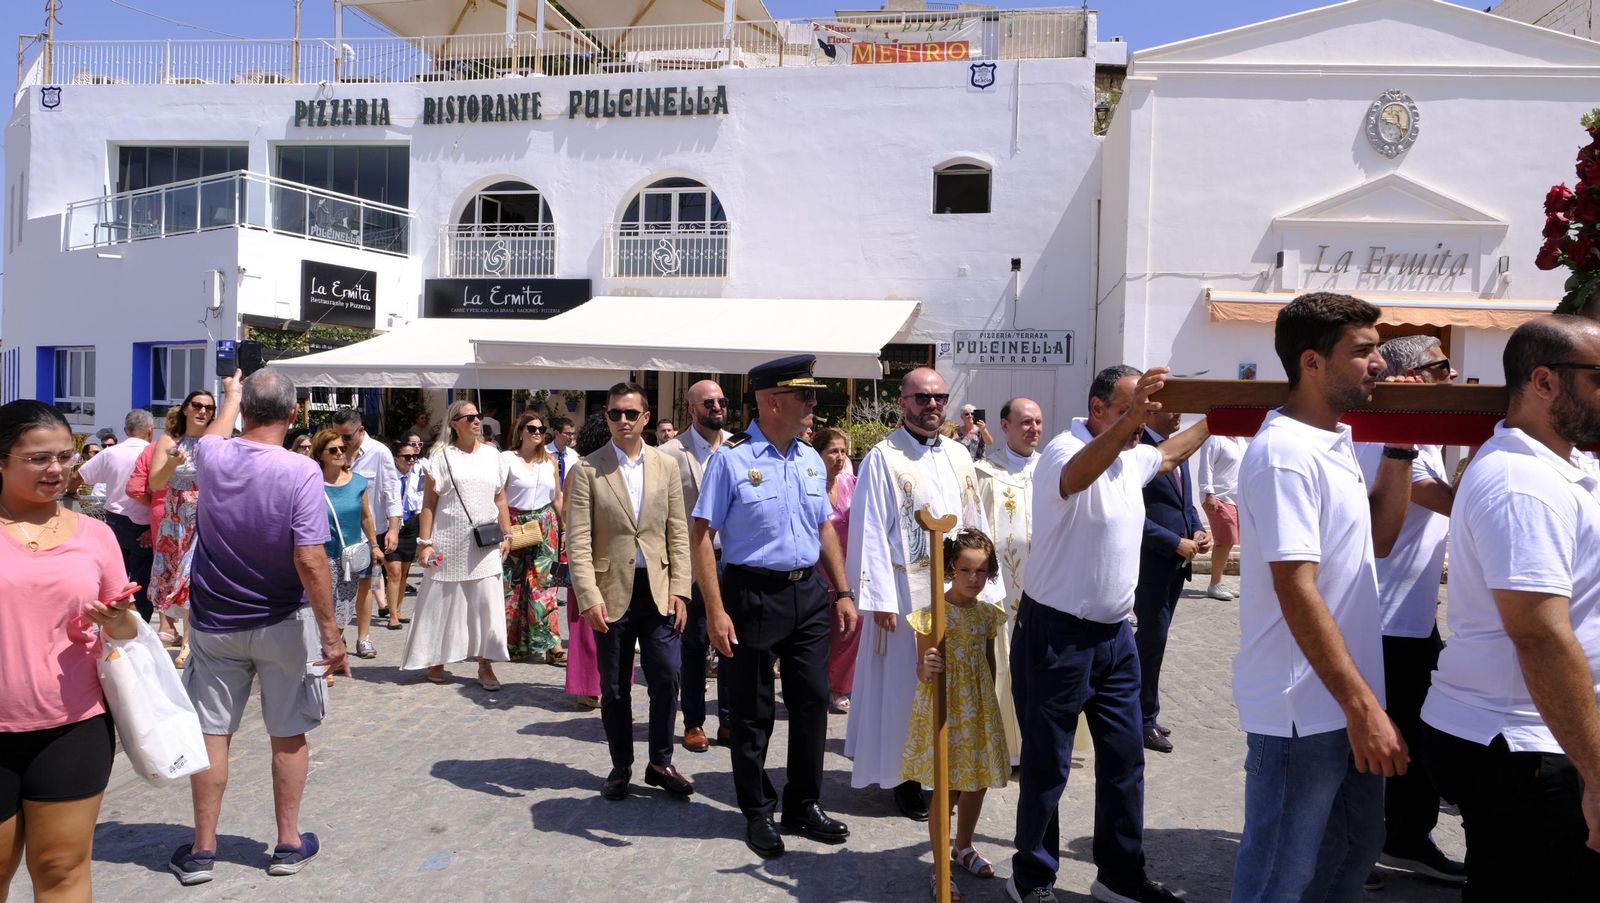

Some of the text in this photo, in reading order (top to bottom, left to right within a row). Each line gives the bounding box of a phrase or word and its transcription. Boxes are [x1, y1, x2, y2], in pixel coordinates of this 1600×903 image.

[813, 23, 857, 33] 2 Planta
[827, 36, 852, 44] Floor
[853, 43, 967, 64] METRO
[294, 85, 729, 127] PIZZERIA RISTORANTE PULCINELLA
[1311, 243, 1469, 276] La Ermita
[311, 277, 371, 302] La Ermita
[463, 285, 544, 306] La Ermita
[310, 296, 344, 306] Restaurante
[350, 302, 371, 310] Pizzeria
[957, 341, 1064, 354] PULCINELLA
